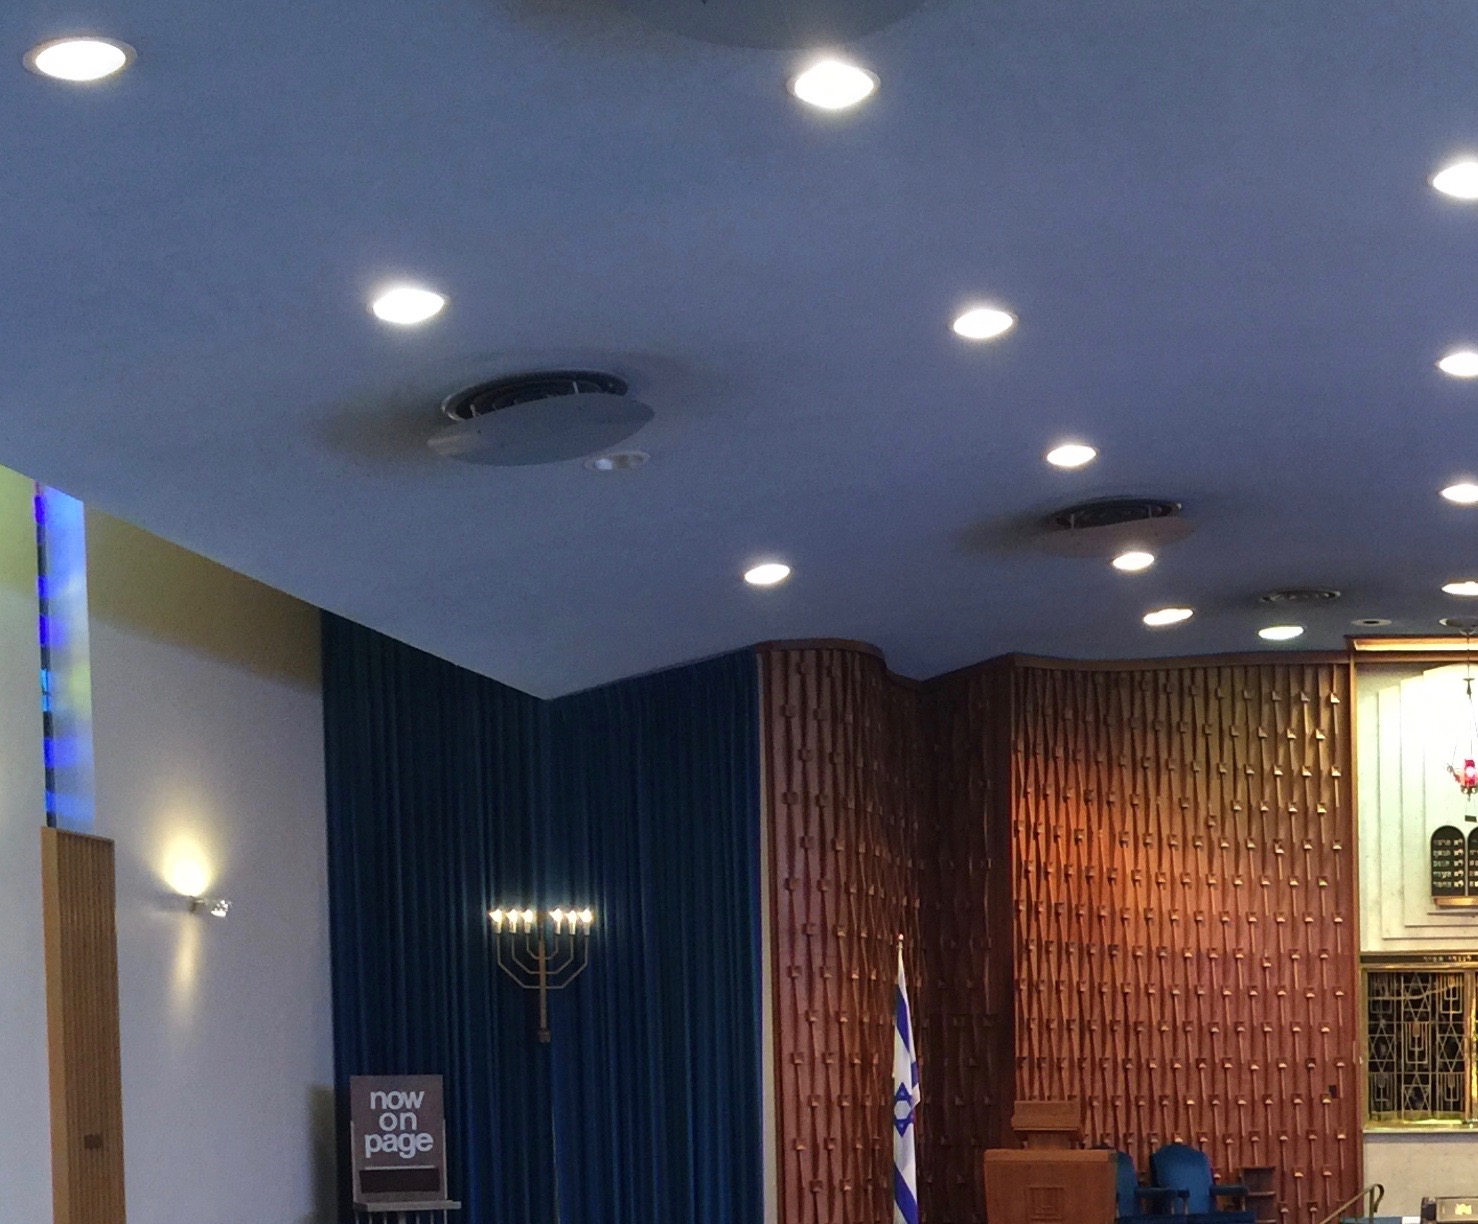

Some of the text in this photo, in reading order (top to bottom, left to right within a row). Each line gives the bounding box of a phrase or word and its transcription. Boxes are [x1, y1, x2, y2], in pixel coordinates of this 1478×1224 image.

[370, 1090, 425, 1110] now
[379, 1112, 418, 1132] on
[364, 1132, 434, 1159] page
